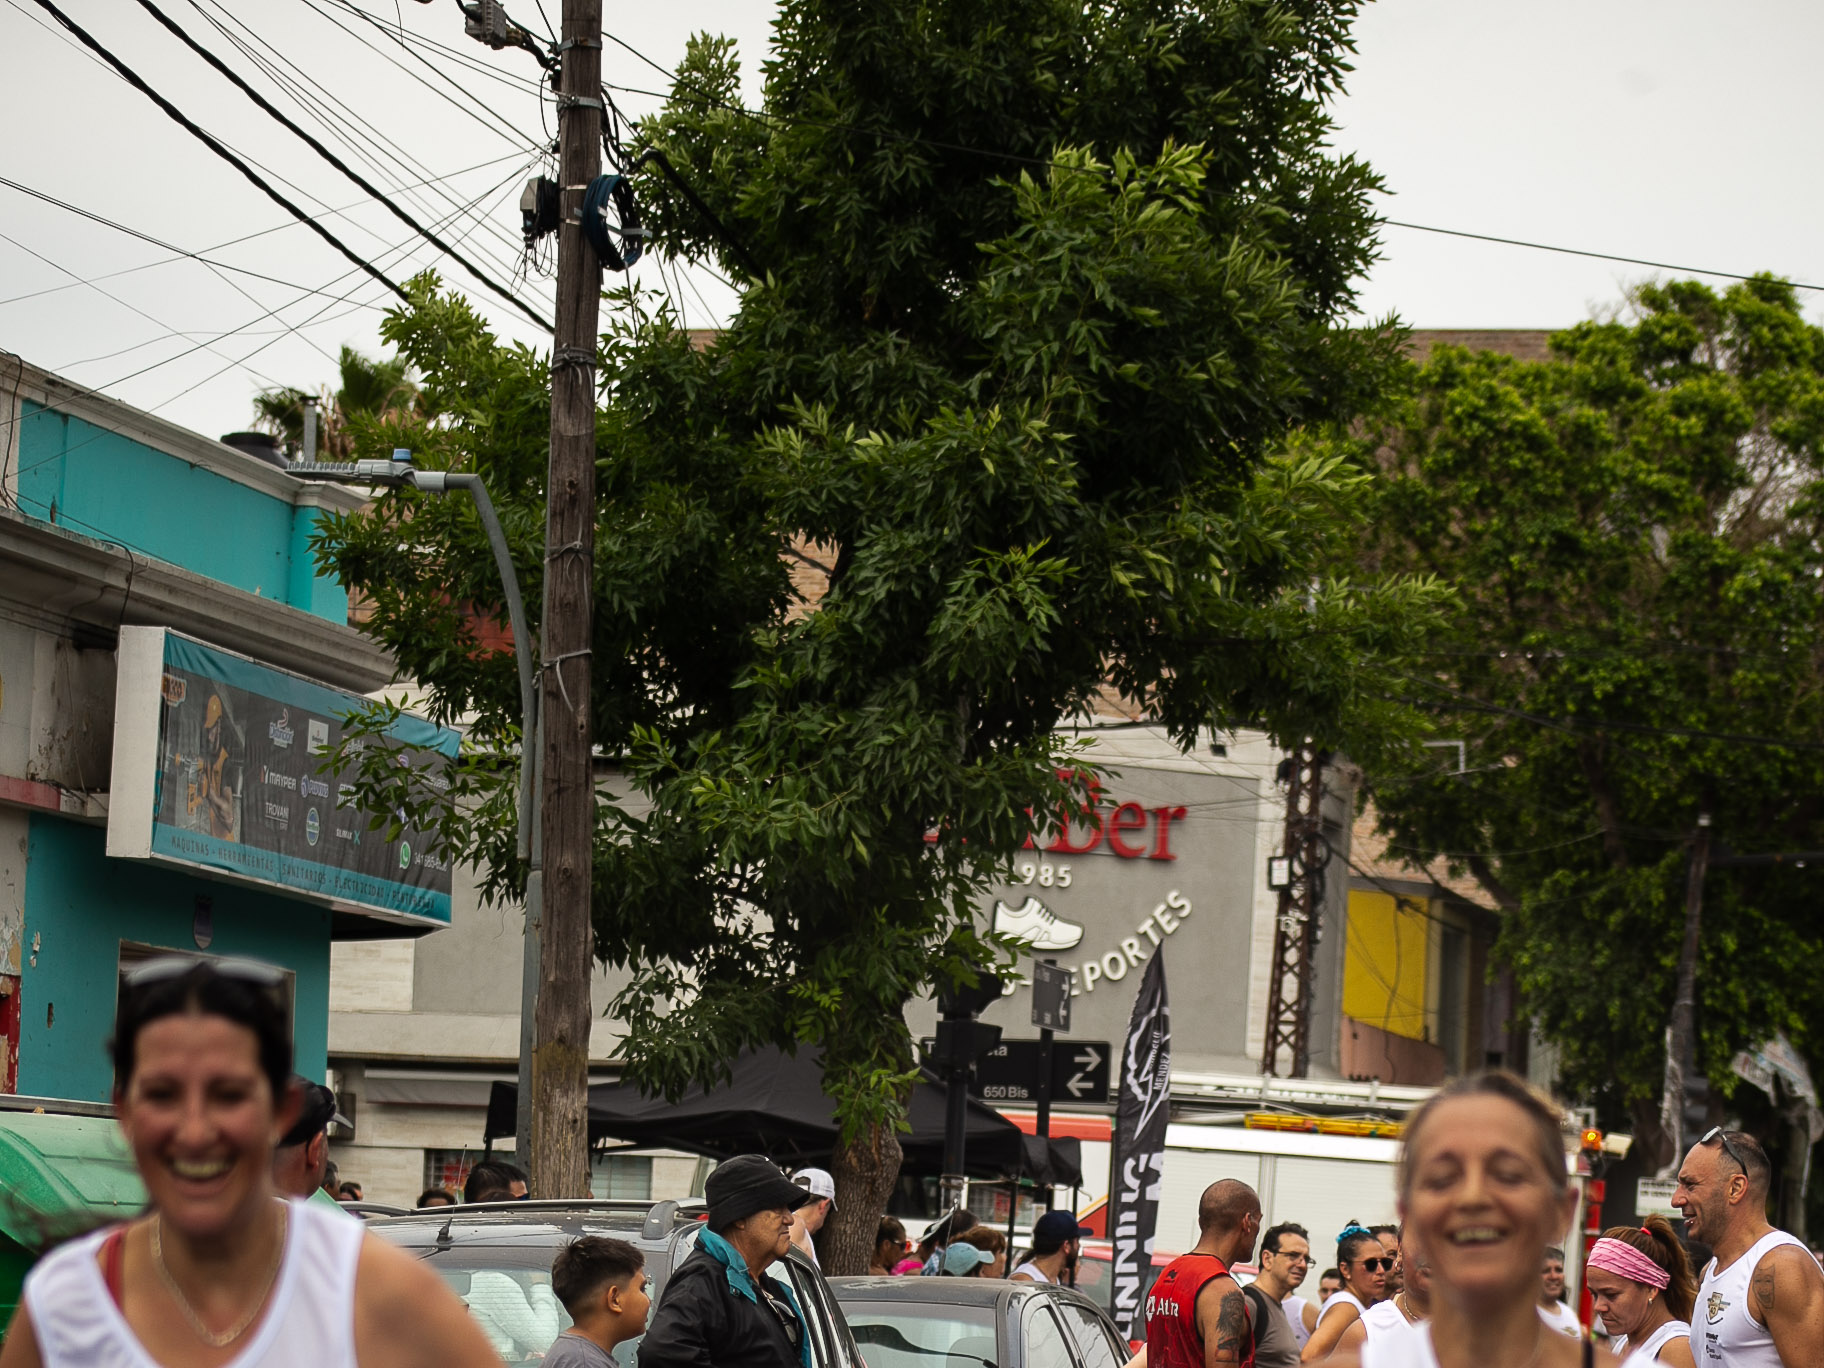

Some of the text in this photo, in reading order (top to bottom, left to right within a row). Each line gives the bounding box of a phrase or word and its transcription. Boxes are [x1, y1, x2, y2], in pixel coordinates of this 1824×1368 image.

[171, 836, 209, 857] MAQUINAS
[218, 848, 274, 873] HERRAMIENTAS
[282, 863, 326, 885] SANITARIOS
[1010, 863, 1073, 888] 985
[1070, 889, 1193, 998] EPORTES
[983, 1086, 1028, 1099] 650 Bis
